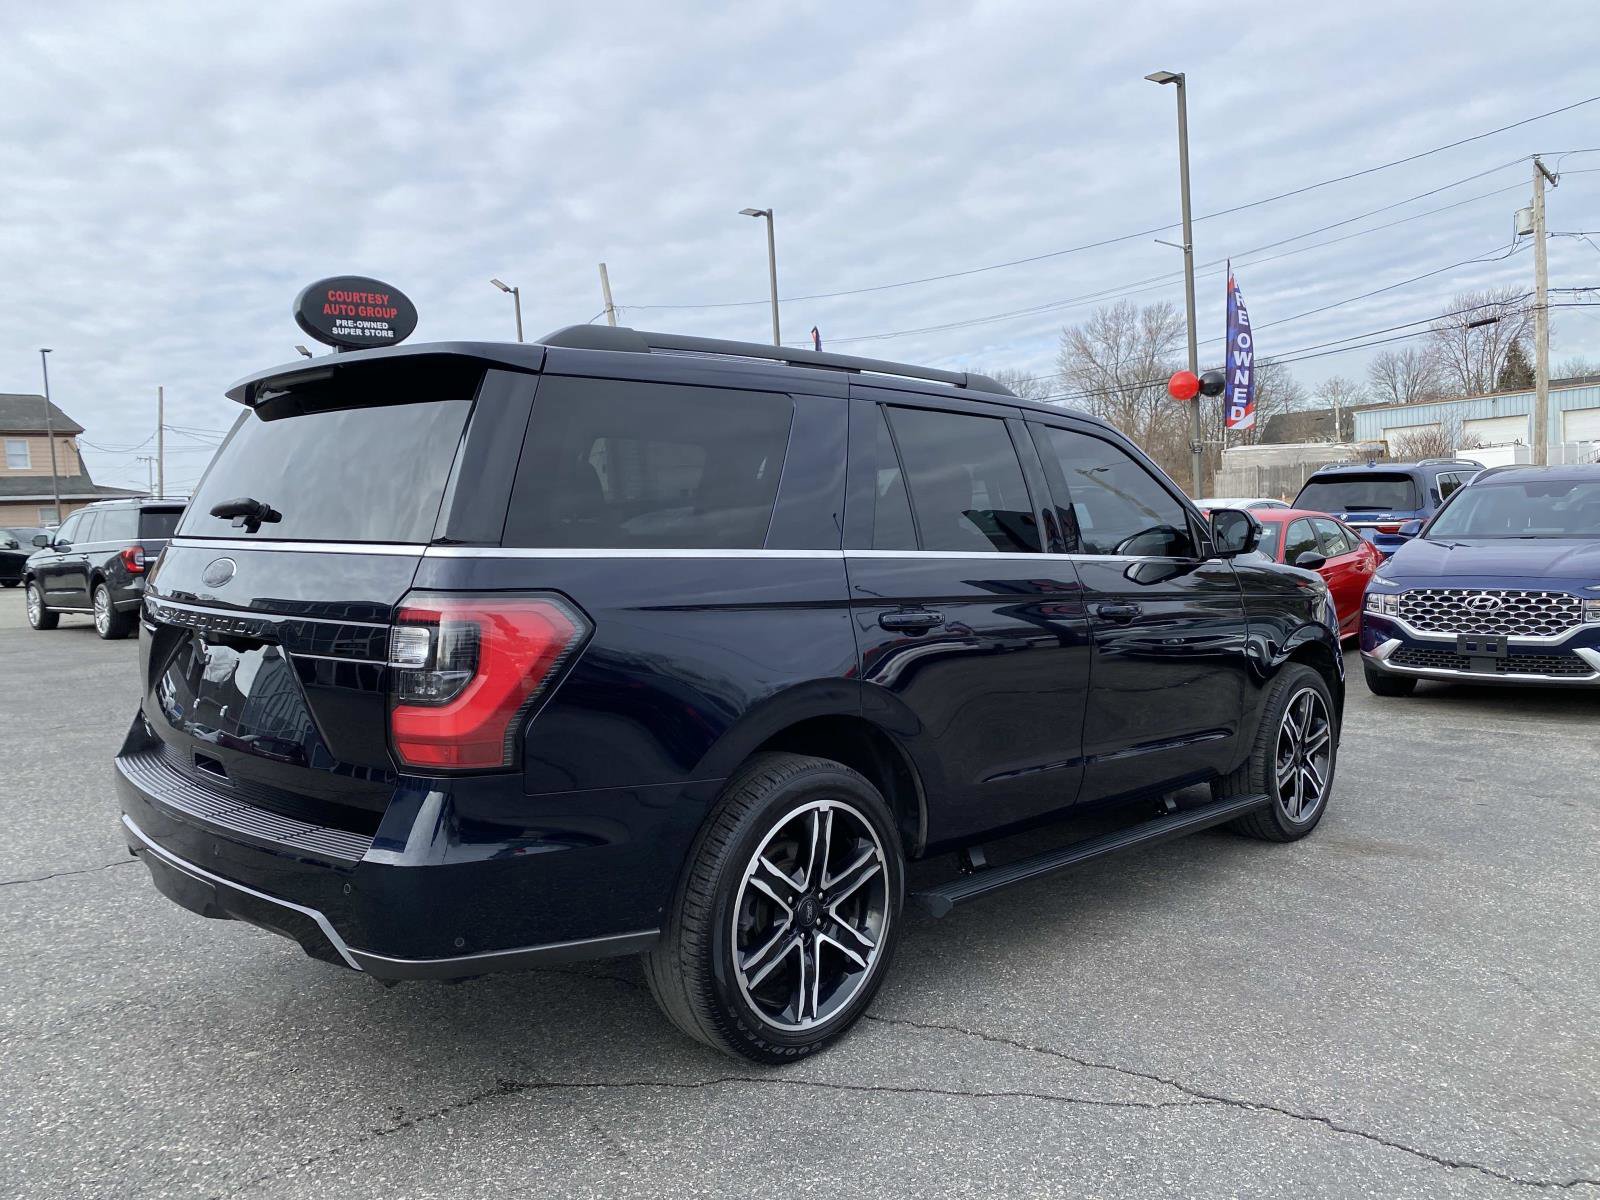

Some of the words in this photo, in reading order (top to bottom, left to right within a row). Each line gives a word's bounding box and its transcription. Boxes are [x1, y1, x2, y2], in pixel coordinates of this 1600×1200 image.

[328, 290, 389, 305] COURTESY
[323, 304, 356, 316] AUTO
[358, 306, 398, 319] GROUP
[332, 327, 363, 335] SUPER
[364, 329, 394, 337] STORE
[336, 320, 388, 329] PRE-OWNED
[1231, 332, 1252, 421] OWNED
